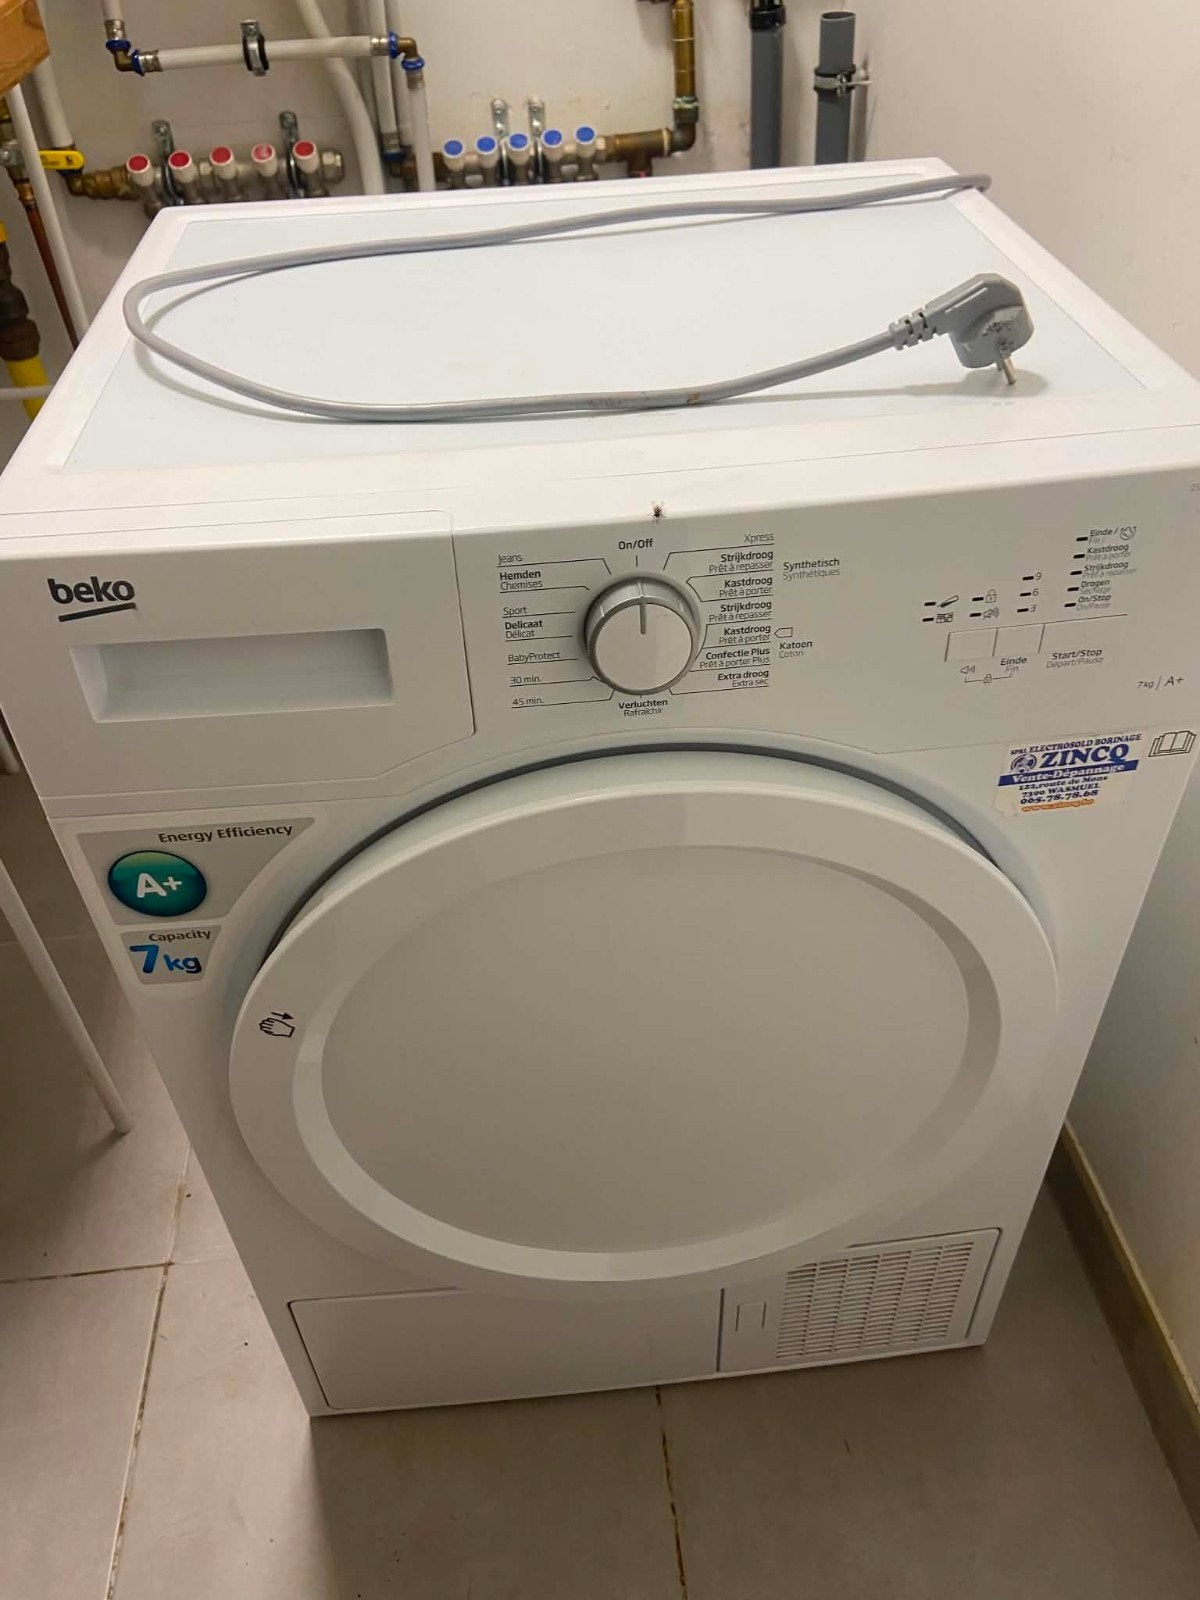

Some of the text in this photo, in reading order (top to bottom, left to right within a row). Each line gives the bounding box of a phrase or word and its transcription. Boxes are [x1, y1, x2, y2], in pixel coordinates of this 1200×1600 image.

[744, 533, 774, 544] Xpress
[1090, 529, 1113, 537] Einde
[618, 538, 653, 550] On/Off
[1087, 544, 1129, 554] Kastdroog
[498, 553, 523, 565] Jeans
[721, 551, 774, 563] Strijkdroog
[736, 561, 774, 573] repasser
[783, 558, 841, 572] Synthetisch
[1083, 562, 1128, 574] Strijkdroog
[500, 570, 541, 581] Hemden
[1035, 571, 1042, 580] 9
[500, 580, 543, 591] Chemises
[724, 577, 773, 588] Kastdroog
[47, 576, 136, 605] beko
[745, 587, 773, 596] porter
[1032, 588, 1039, 596] 6
[503, 606, 527, 616] Sport
[720, 601, 772, 612] Strijkdroog
[1029, 604, 1037, 612] 3
[735, 611, 772, 620] repasser
[505, 620, 543, 630] Delicaat
[724, 625, 771, 636] Kastdroog
[744, 634, 771, 644] porter
[779, 640, 813, 650] Katoen
[508, 652, 561, 663] BabyProtect
[706, 647, 770, 660] Confectie Plus
[1052, 649, 1102, 660] Start/Stop
[725, 658, 750, 668] porter
[752, 656, 770, 664] Plus
[1000, 656, 1028, 666] Einde
[510, 675, 542, 684] 30 min.
[717, 669, 769, 682] Extra droog
[1163, 675, 1185, 687] A+
[732, 679, 754, 688] Extra
[512, 697, 544, 706] 45 min.
[618, 700, 668, 709] Verluchten
[1029, 740, 1093, 753] ELECTROSOLD
[1094, 734, 1142, 746] BORINAGE
[1048, 783, 1100, 794] WASMUEL
[158, 825, 293, 843] Energy Efficiency
[136, 872, 182, 898] A+
[148, 930, 211, 942] Capacity
